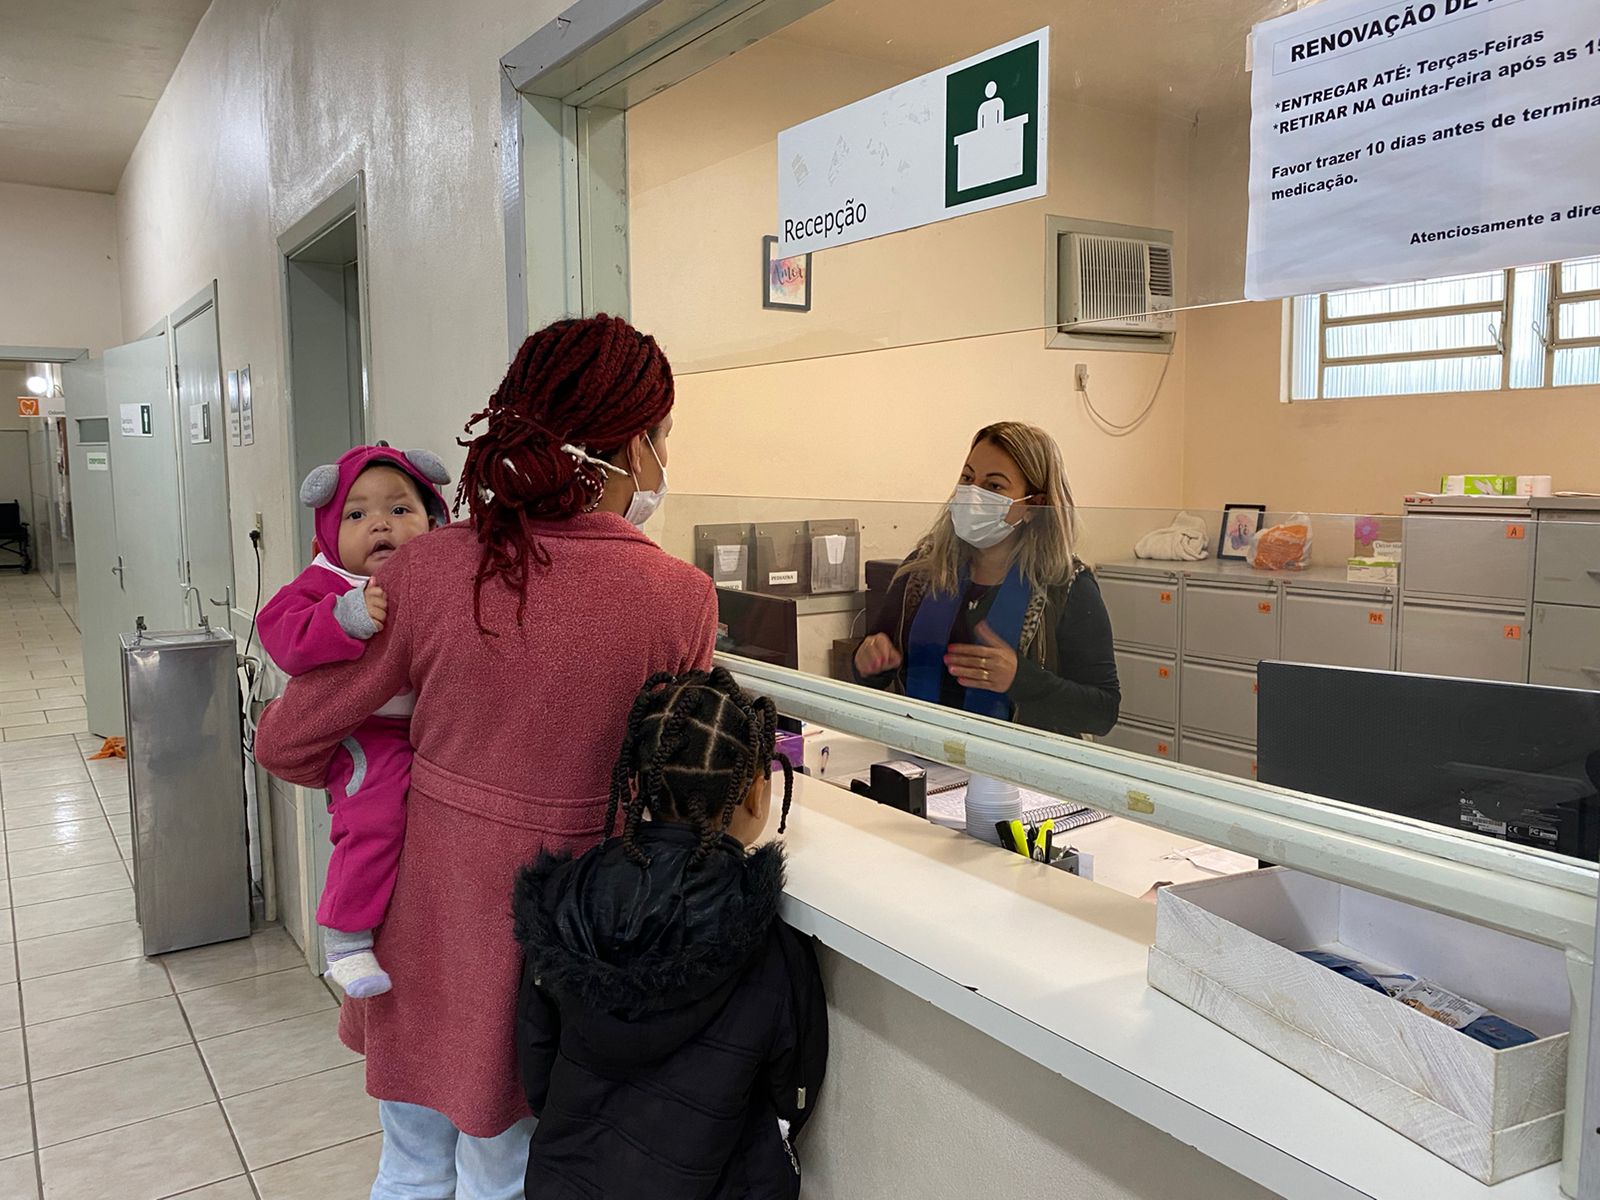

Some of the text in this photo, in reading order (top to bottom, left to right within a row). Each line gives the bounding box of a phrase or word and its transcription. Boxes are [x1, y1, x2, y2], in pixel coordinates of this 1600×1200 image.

[1291, 4, 1436, 62] RENOVAÇÃO
[1372, 64, 1411, 87] ATÉ:
[1417, 30, 1544, 74] Terças-Feiras
[1352, 98, 1376, 115] NA
[1382, 70, 1491, 107] Quinta-Feira
[1498, 55, 1547, 78] após
[1553, 48, 1577, 63] as
[1585, 39, 1600, 54] 1
[1272, 95, 1600, 179] Favor trazer 10 dias antes de termina
[1271, 174, 1358, 201] medicação.
[784, 198, 867, 243] Recepção
[1410, 214, 1544, 245] Atenciosamente
[1550, 211, 1561, 222] a
[1510, 527, 1518, 537] A
